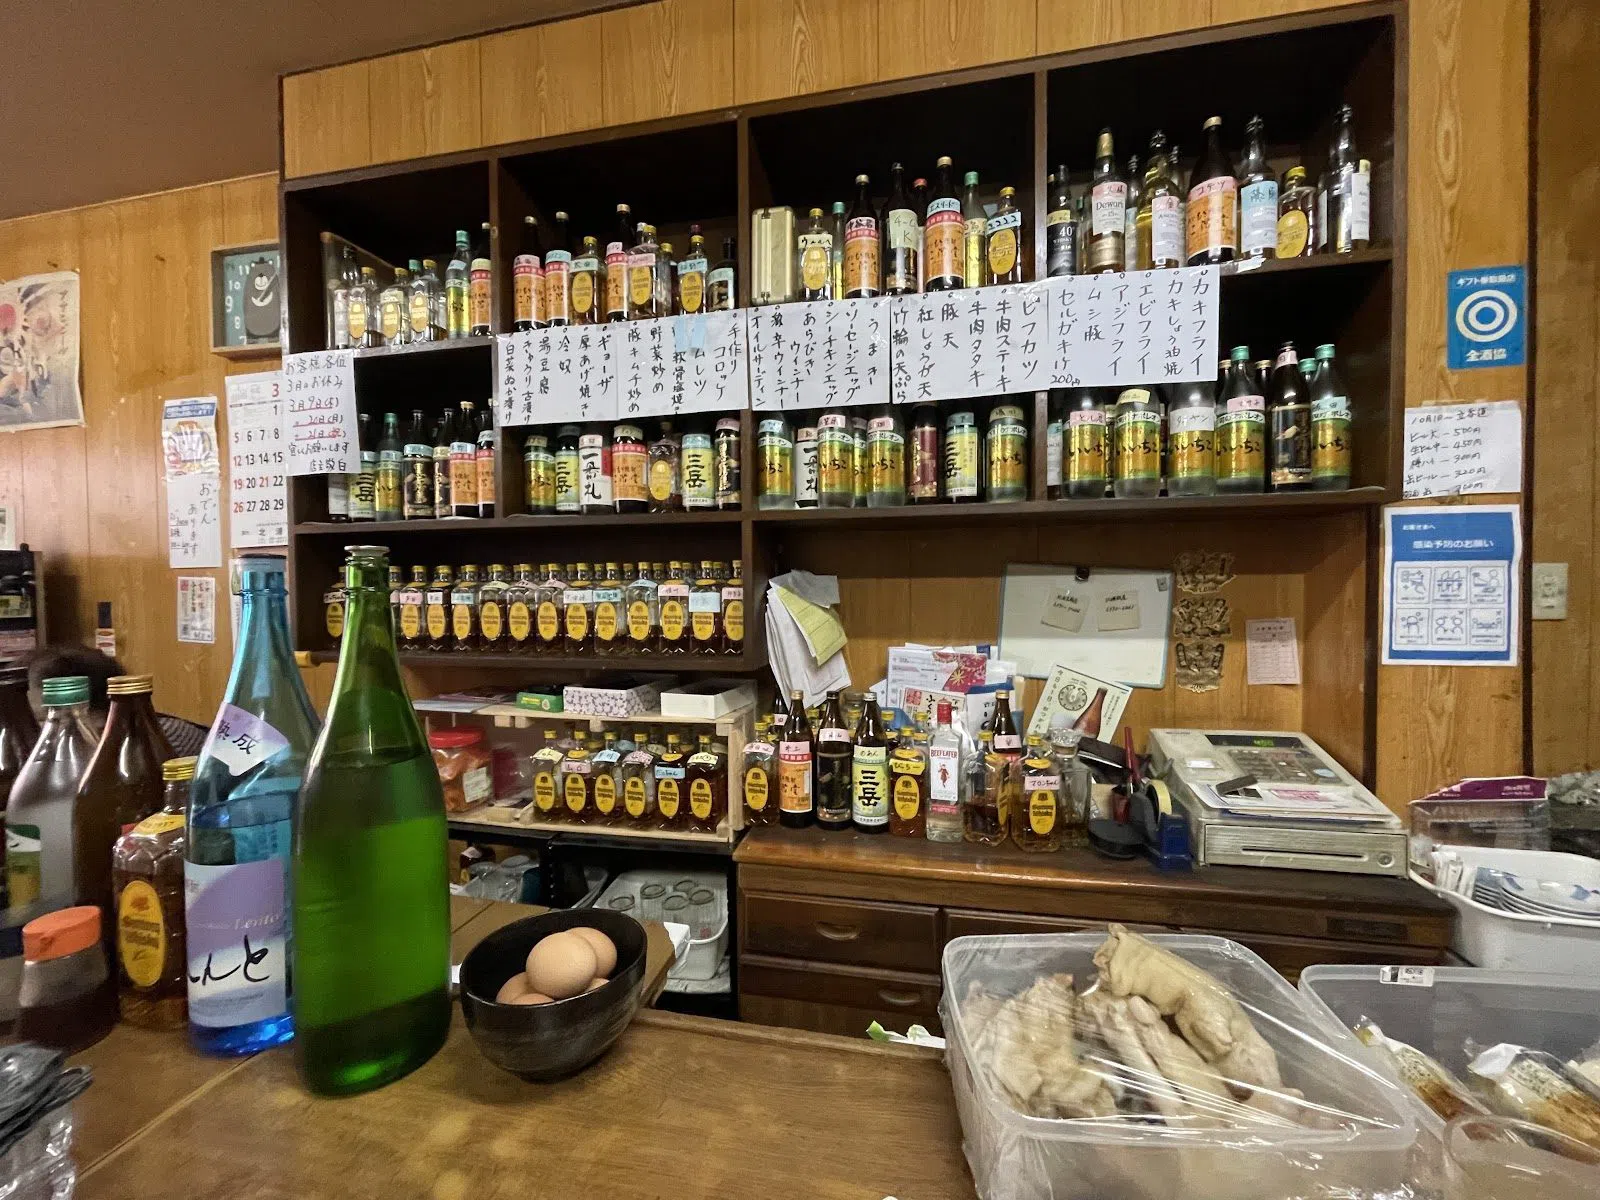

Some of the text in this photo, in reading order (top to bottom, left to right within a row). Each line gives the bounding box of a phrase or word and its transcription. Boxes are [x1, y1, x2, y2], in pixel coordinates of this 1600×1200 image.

[1060, 225, 1073, 236] 40
[229, 280, 241, 291] 10
[239, 265, 250, 276] 11
[225, 295, 233, 313] 9
[235, 316, 241, 330] 8
[942, 302, 960, 349] 豚天
[1084, 288, 1105, 341] ムシ豚
[1164, 279, 1184, 376] カキしょう油焼
[1191, 278, 1210, 376] カキフライ
[558, 335, 572, 374] 冷奴
[728, 323, 742, 375] 手作り
[893, 306, 911, 403] 竹輪の天ぷら
[917, 305, 935, 398] 紅しょうが天
[968, 301, 987, 388] 牛肉タタキ
[996, 299, 1011, 392] 牛肉ステーキ
[1021, 297, 1041, 380] ビフカツ
[1108, 284, 1131, 376] アジフライ
[1138, 284, 1156, 375] エビフライ
[597, 334, 614, 395] ギョーザ
[628, 327, 642, 412] 豚キムチ炒め
[651, 325, 666, 393] 野菜炒め
[694, 347, 706, 395] ムレツ
[714, 347, 727, 400] コロッケ
[751, 315, 768, 407] オイルサーディン
[790, 340, 804, 402] ウインナー
[823, 311, 839, 405] シーチキンエッグ
[844, 309, 860, 402] ソーセージエッグ
[272, 384, 280, 398] 3
[273, 404, 278, 416] 1
[233, 452, 283, 466] 12 13 14 15
[234, 428, 280, 443] 5 6 7 8
[989, 451, 1021, 467] いいち
[1068, 440, 1103, 458] いいち
[1216, 436, 1260, 457] いいちこ
[234, 475, 283, 490] 19 20 21 22
[555, 461, 573, 495] 三岳
[686, 453, 708, 489] 三岳
[233, 499, 284, 513] 26 27 28 29
[858, 769, 882, 807] 三岳
[188, 934, 270, 986] んと
